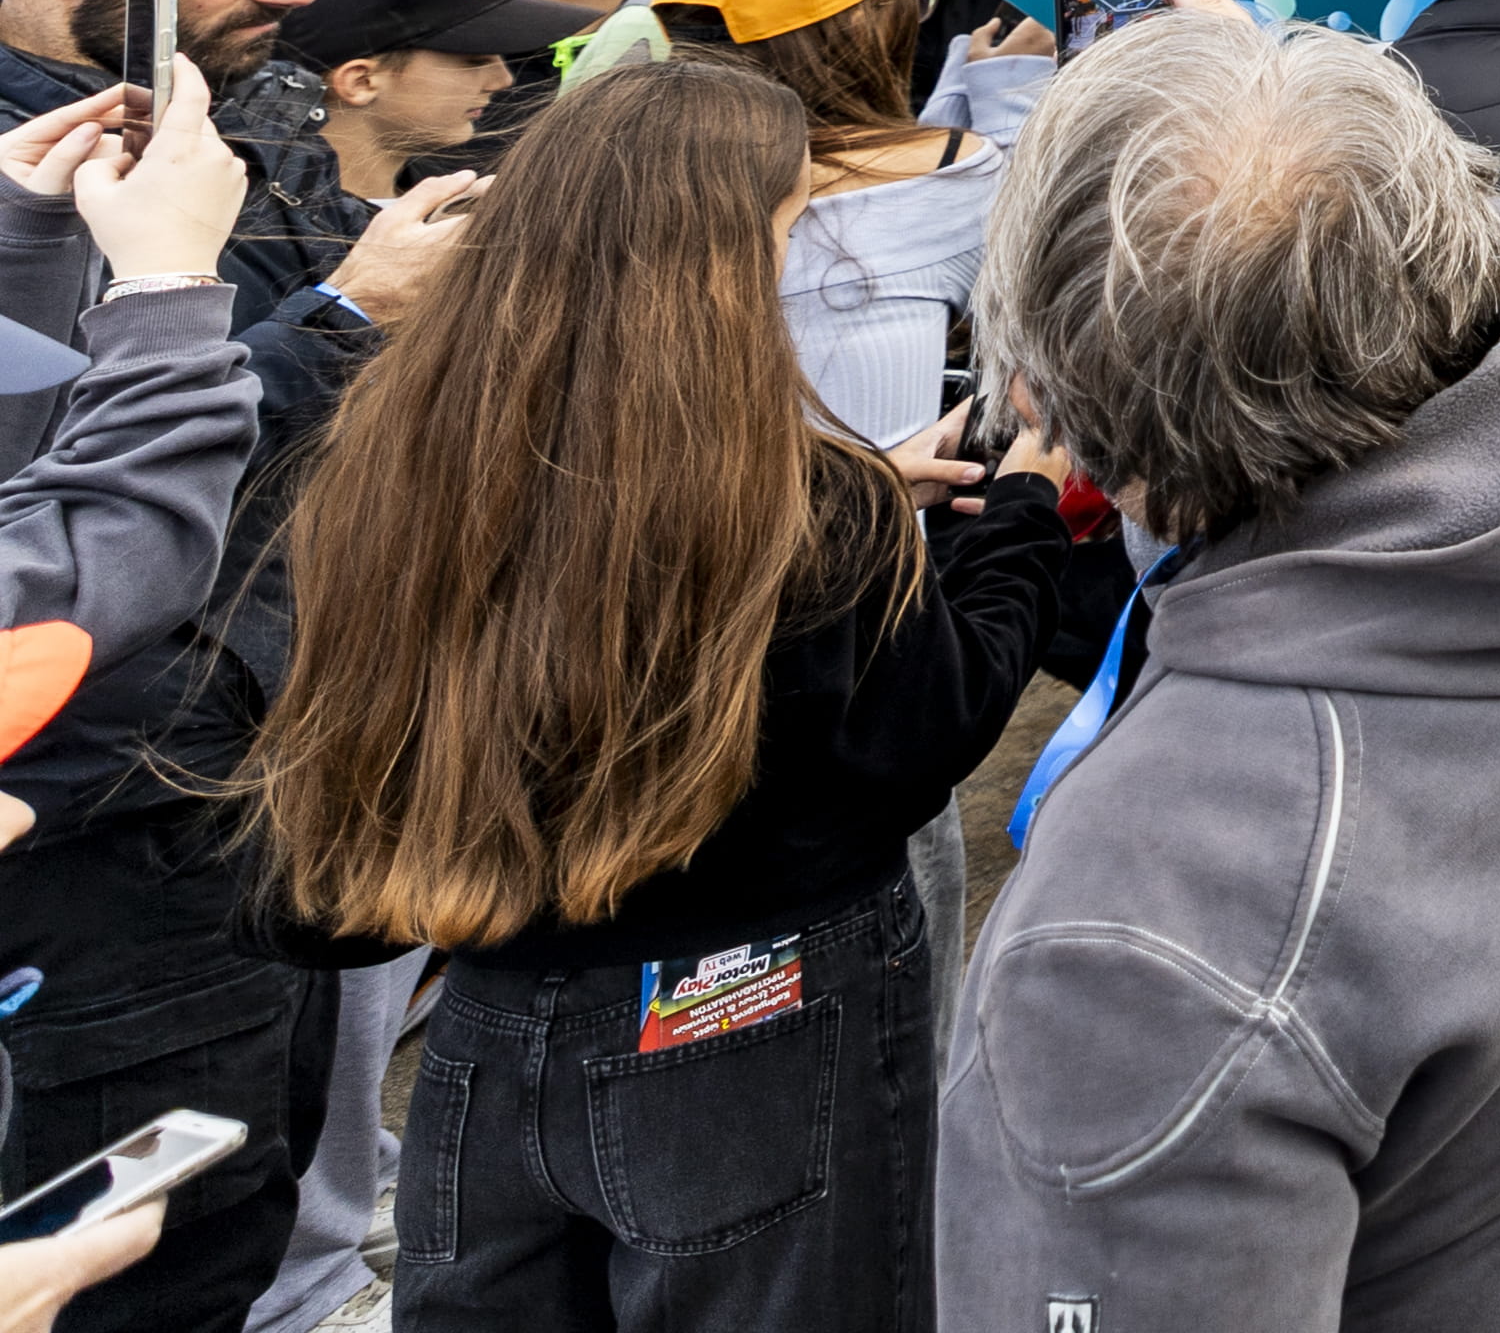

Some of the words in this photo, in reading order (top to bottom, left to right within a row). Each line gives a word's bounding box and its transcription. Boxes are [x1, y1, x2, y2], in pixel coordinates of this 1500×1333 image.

[718, 952, 743, 967] web
[703, 960, 718, 972] TV
[720, 1018, 731, 1030] 2
